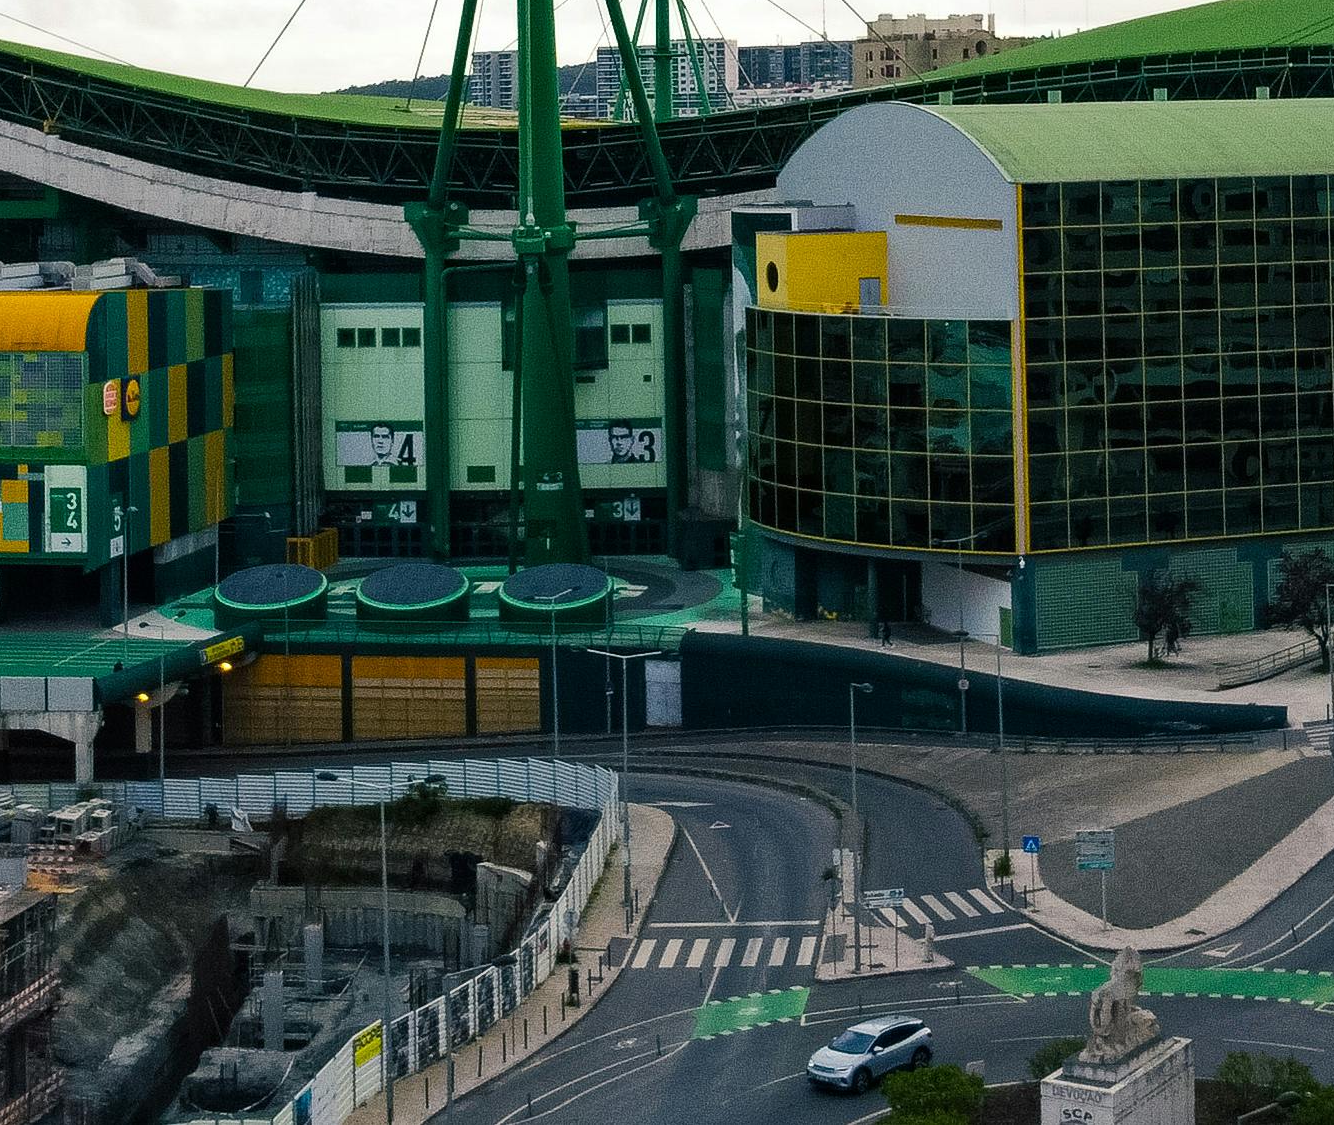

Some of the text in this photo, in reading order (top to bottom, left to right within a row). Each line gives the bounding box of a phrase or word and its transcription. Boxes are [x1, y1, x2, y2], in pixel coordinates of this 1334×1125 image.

[397, 433, 417, 465] 4
[637, 430, 656, 463] 3
[66, 492, 78, 510] 3
[612, 501, 624, 518] 3
[66, 511, 79, 529] 4
[388, 503, 400, 520] 4
[1062, 1107, 1093, 1121] SCP
